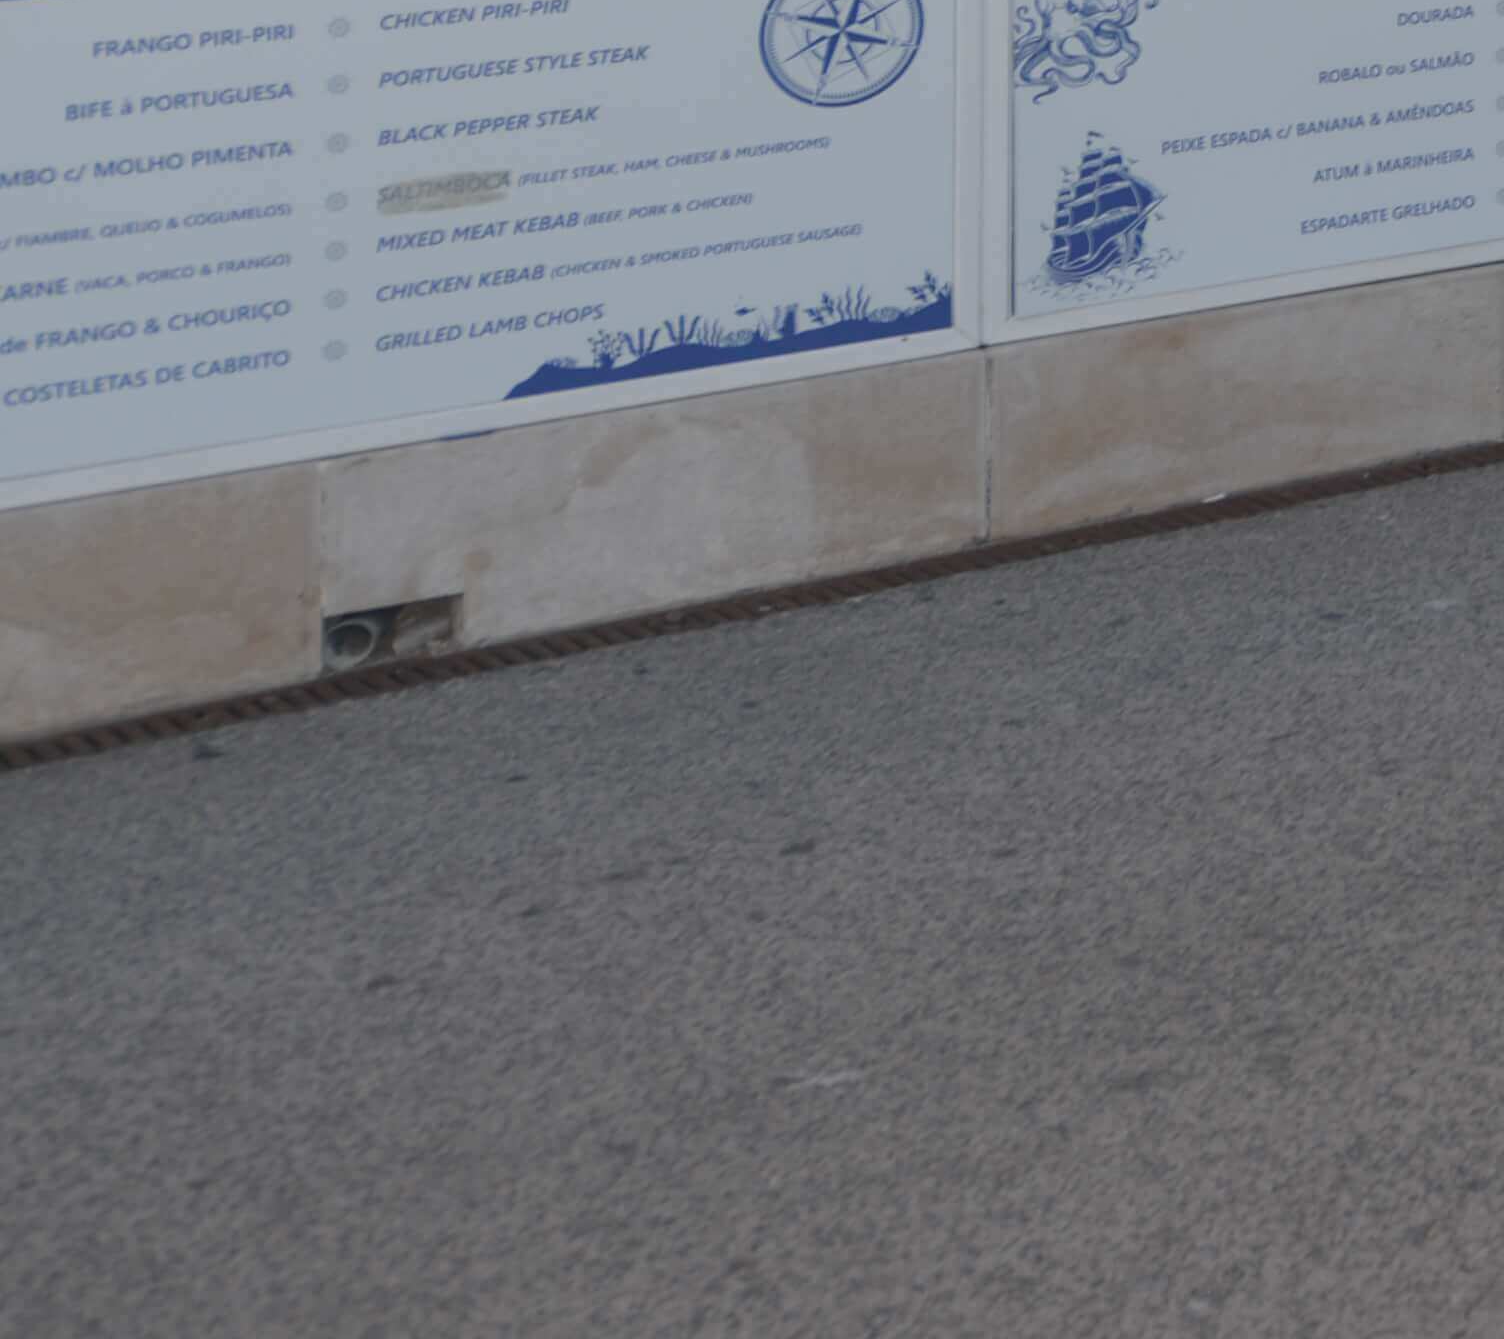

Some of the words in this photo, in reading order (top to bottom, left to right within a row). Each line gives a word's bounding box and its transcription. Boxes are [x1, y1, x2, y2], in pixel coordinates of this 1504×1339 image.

[380, 7, 477, 31] CHICKEN
[1397, 5, 1474, 27] DOURADA
[93, 33, 194, 57] FRANGO
[199, 24, 295, 48] PIRI-PIRI
[379, 59, 519, 87] PORTUGUESE
[524, 52, 583, 73] STYLE
[588, 45, 649, 66] STEAK
[65, 100, 113, 121] BIFE
[140, 83, 295, 112] PORTUGUESA
[378, 123, 448, 146] BLACK
[453, 113, 532, 137] PEPPER
[537, 106, 600, 128] STEAK
[377, 229, 446, 253] MIXED
[451, 220, 509, 243] MEAT
[513, 212, 578, 235] KEBAB
[376, 275, 474, 302] CHICKEN
[478, 264, 545, 288] KEBAB
[34, 320, 138, 350] FRANGO
[168, 299, 292, 331] CHOURIÇO
[375, 324, 464, 352] GRILLED
[469, 315, 528, 339] LAMB
[534, 303, 606, 328] CHOPS
[2, 370, 149, 407] COSTELETAS
[155, 364, 186, 386] DE
[192, 349, 292, 379] CABRITO
